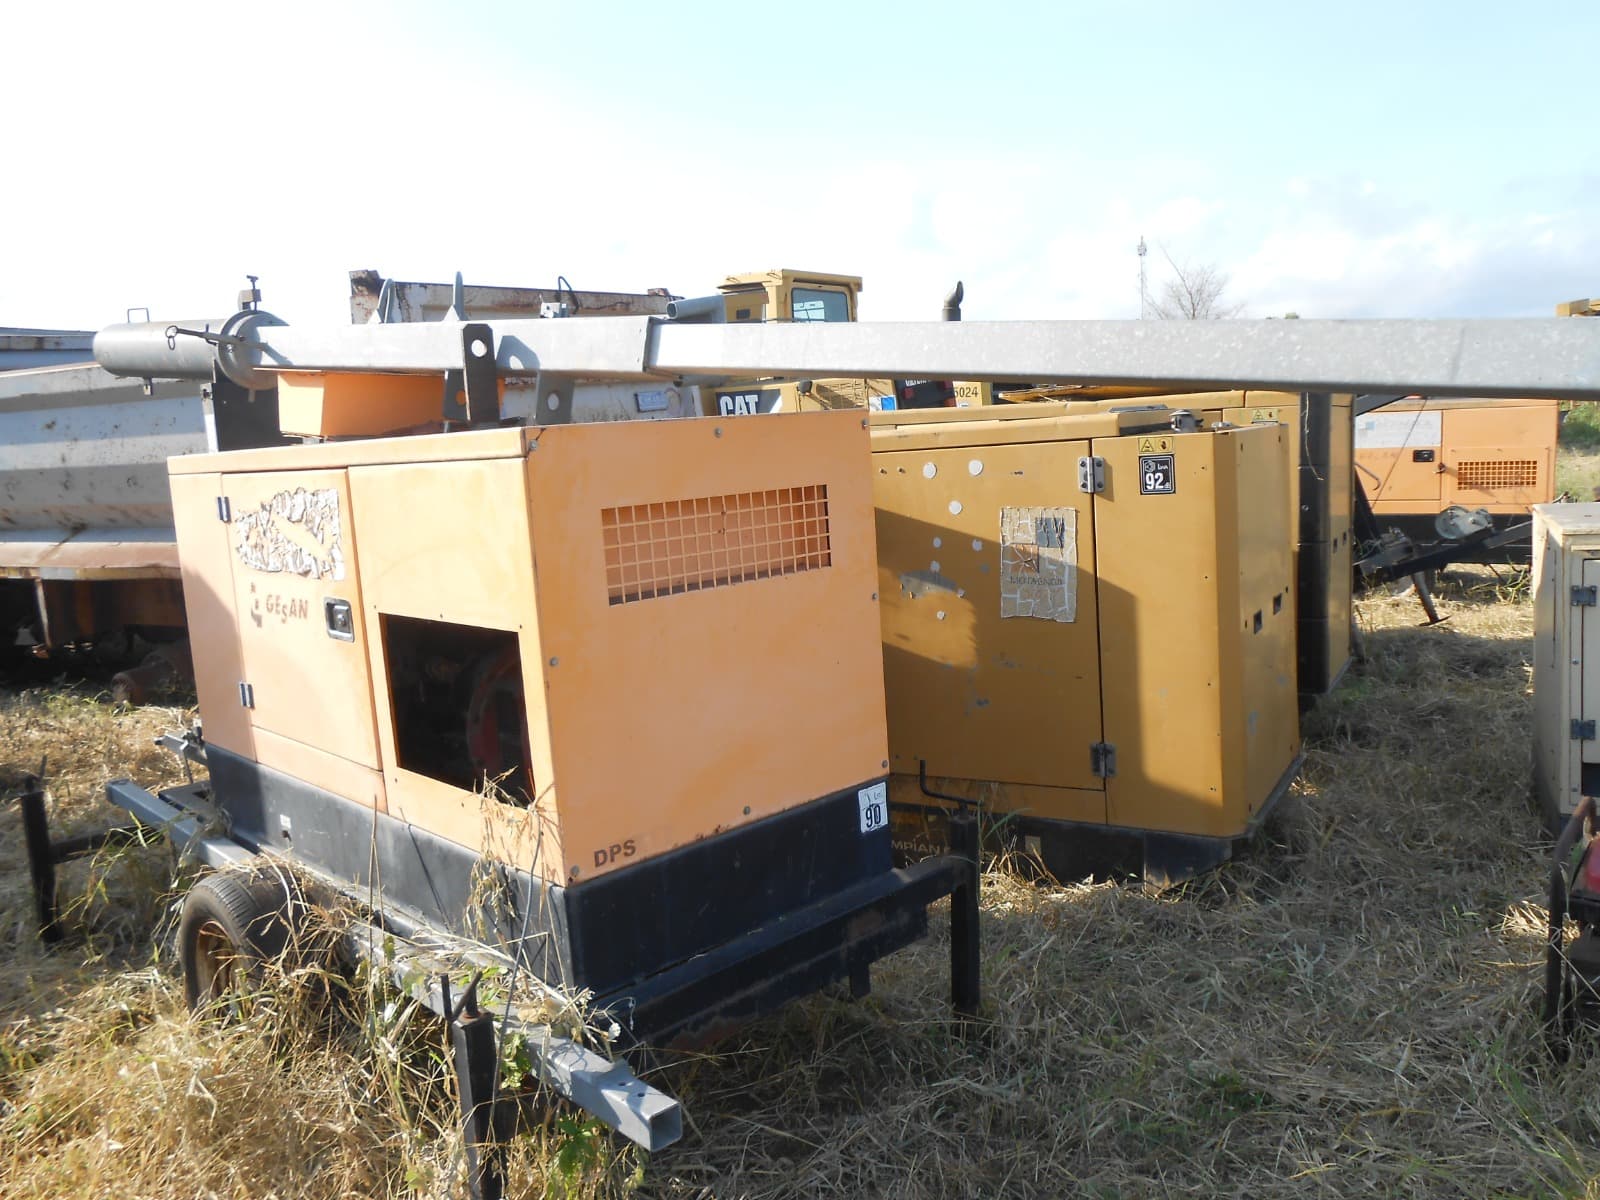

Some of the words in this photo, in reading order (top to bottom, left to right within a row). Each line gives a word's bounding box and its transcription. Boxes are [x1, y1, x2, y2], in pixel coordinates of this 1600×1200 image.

[719, 394, 759, 416] CAT
[1145, 472, 1164, 490] 92
[865, 804, 882, 828] 90
[594, 839, 637, 868] DPS
